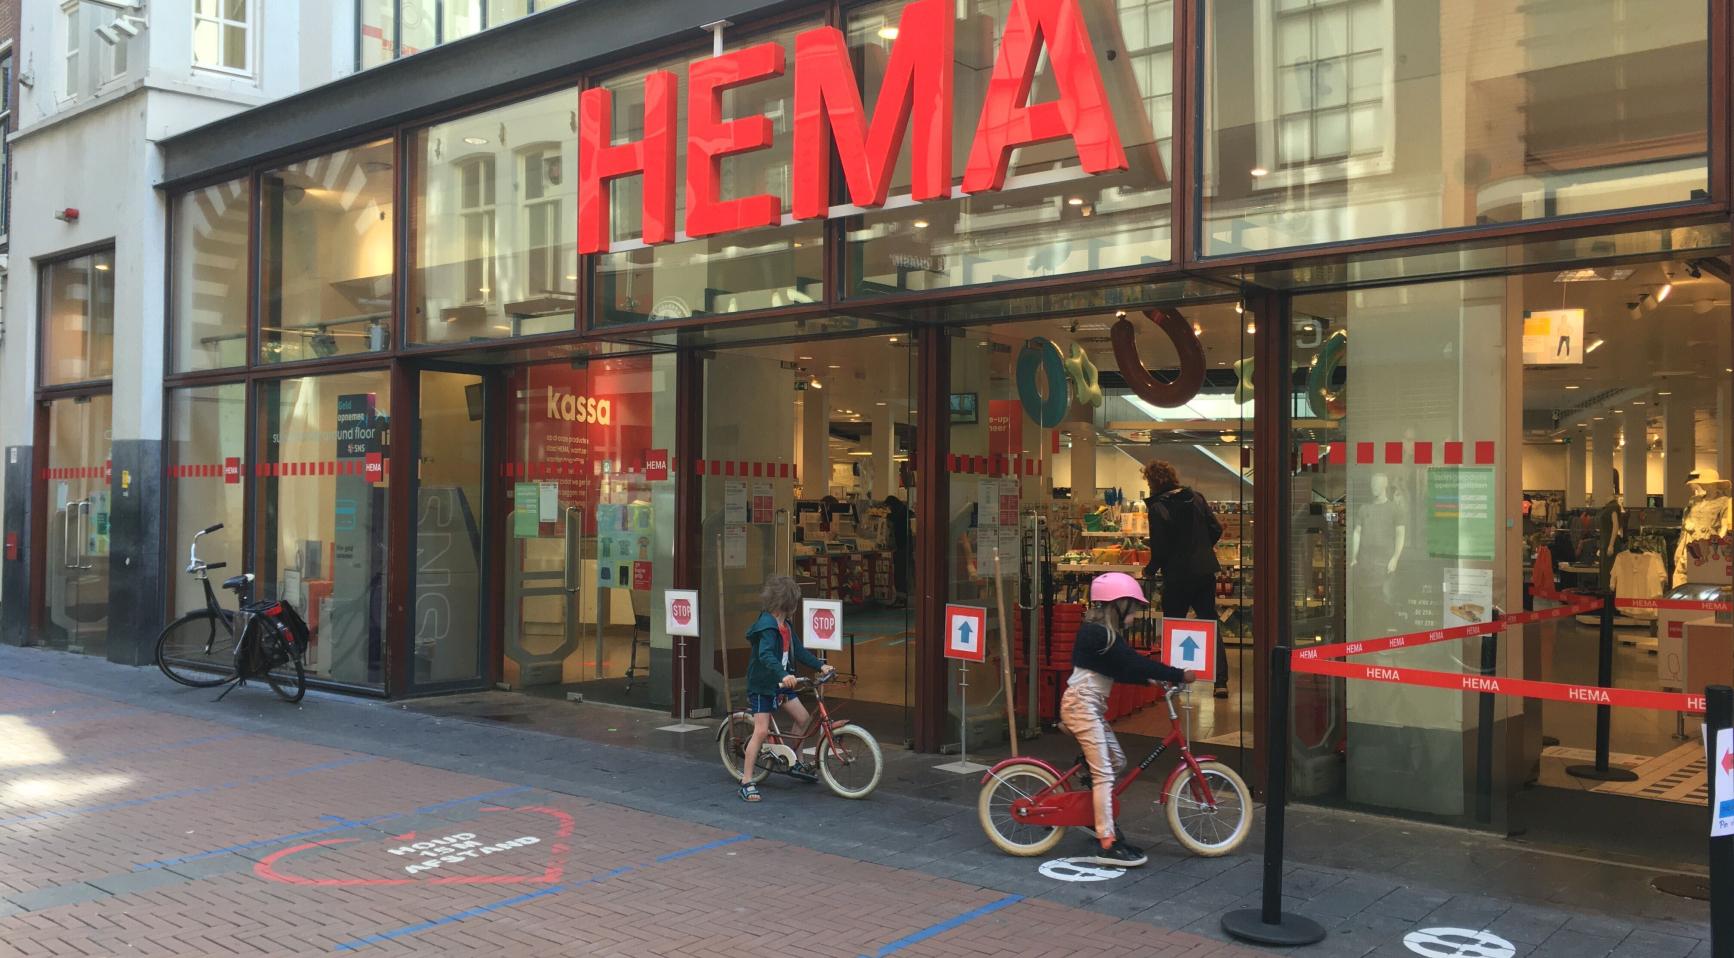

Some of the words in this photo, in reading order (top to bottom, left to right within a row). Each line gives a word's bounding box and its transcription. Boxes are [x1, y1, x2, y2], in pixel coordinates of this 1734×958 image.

[578, 0, 1129, 255] HEMA
[547, 385, 611, 426] kassa
[355, 427, 375, 440] floor
[365, 462, 382, 472] HEMA
[646, 460, 667, 471] HEMA
[673, 605, 691, 617] STOP
[1632, 599, 1658, 608] HEMA
[1702, 602, 1728, 611] HEMA
[814, 617, 835, 631] STOP
[1299, 649, 1319, 660] HEMA
[1346, 642, 1364, 654] HEMA
[1389, 637, 1406, 648] HEMA
[1429, 631, 1445, 642] HEMA
[1366, 667, 1401, 681] HEMA
[1462, 677, 1501, 692] HEMA
[1569, 687, 1611, 703] HEMA
[1687, 696, 1707, 711] HE
[387, 832, 477, 856] HOUD
[405, 836, 541, 874] AFSTAND
